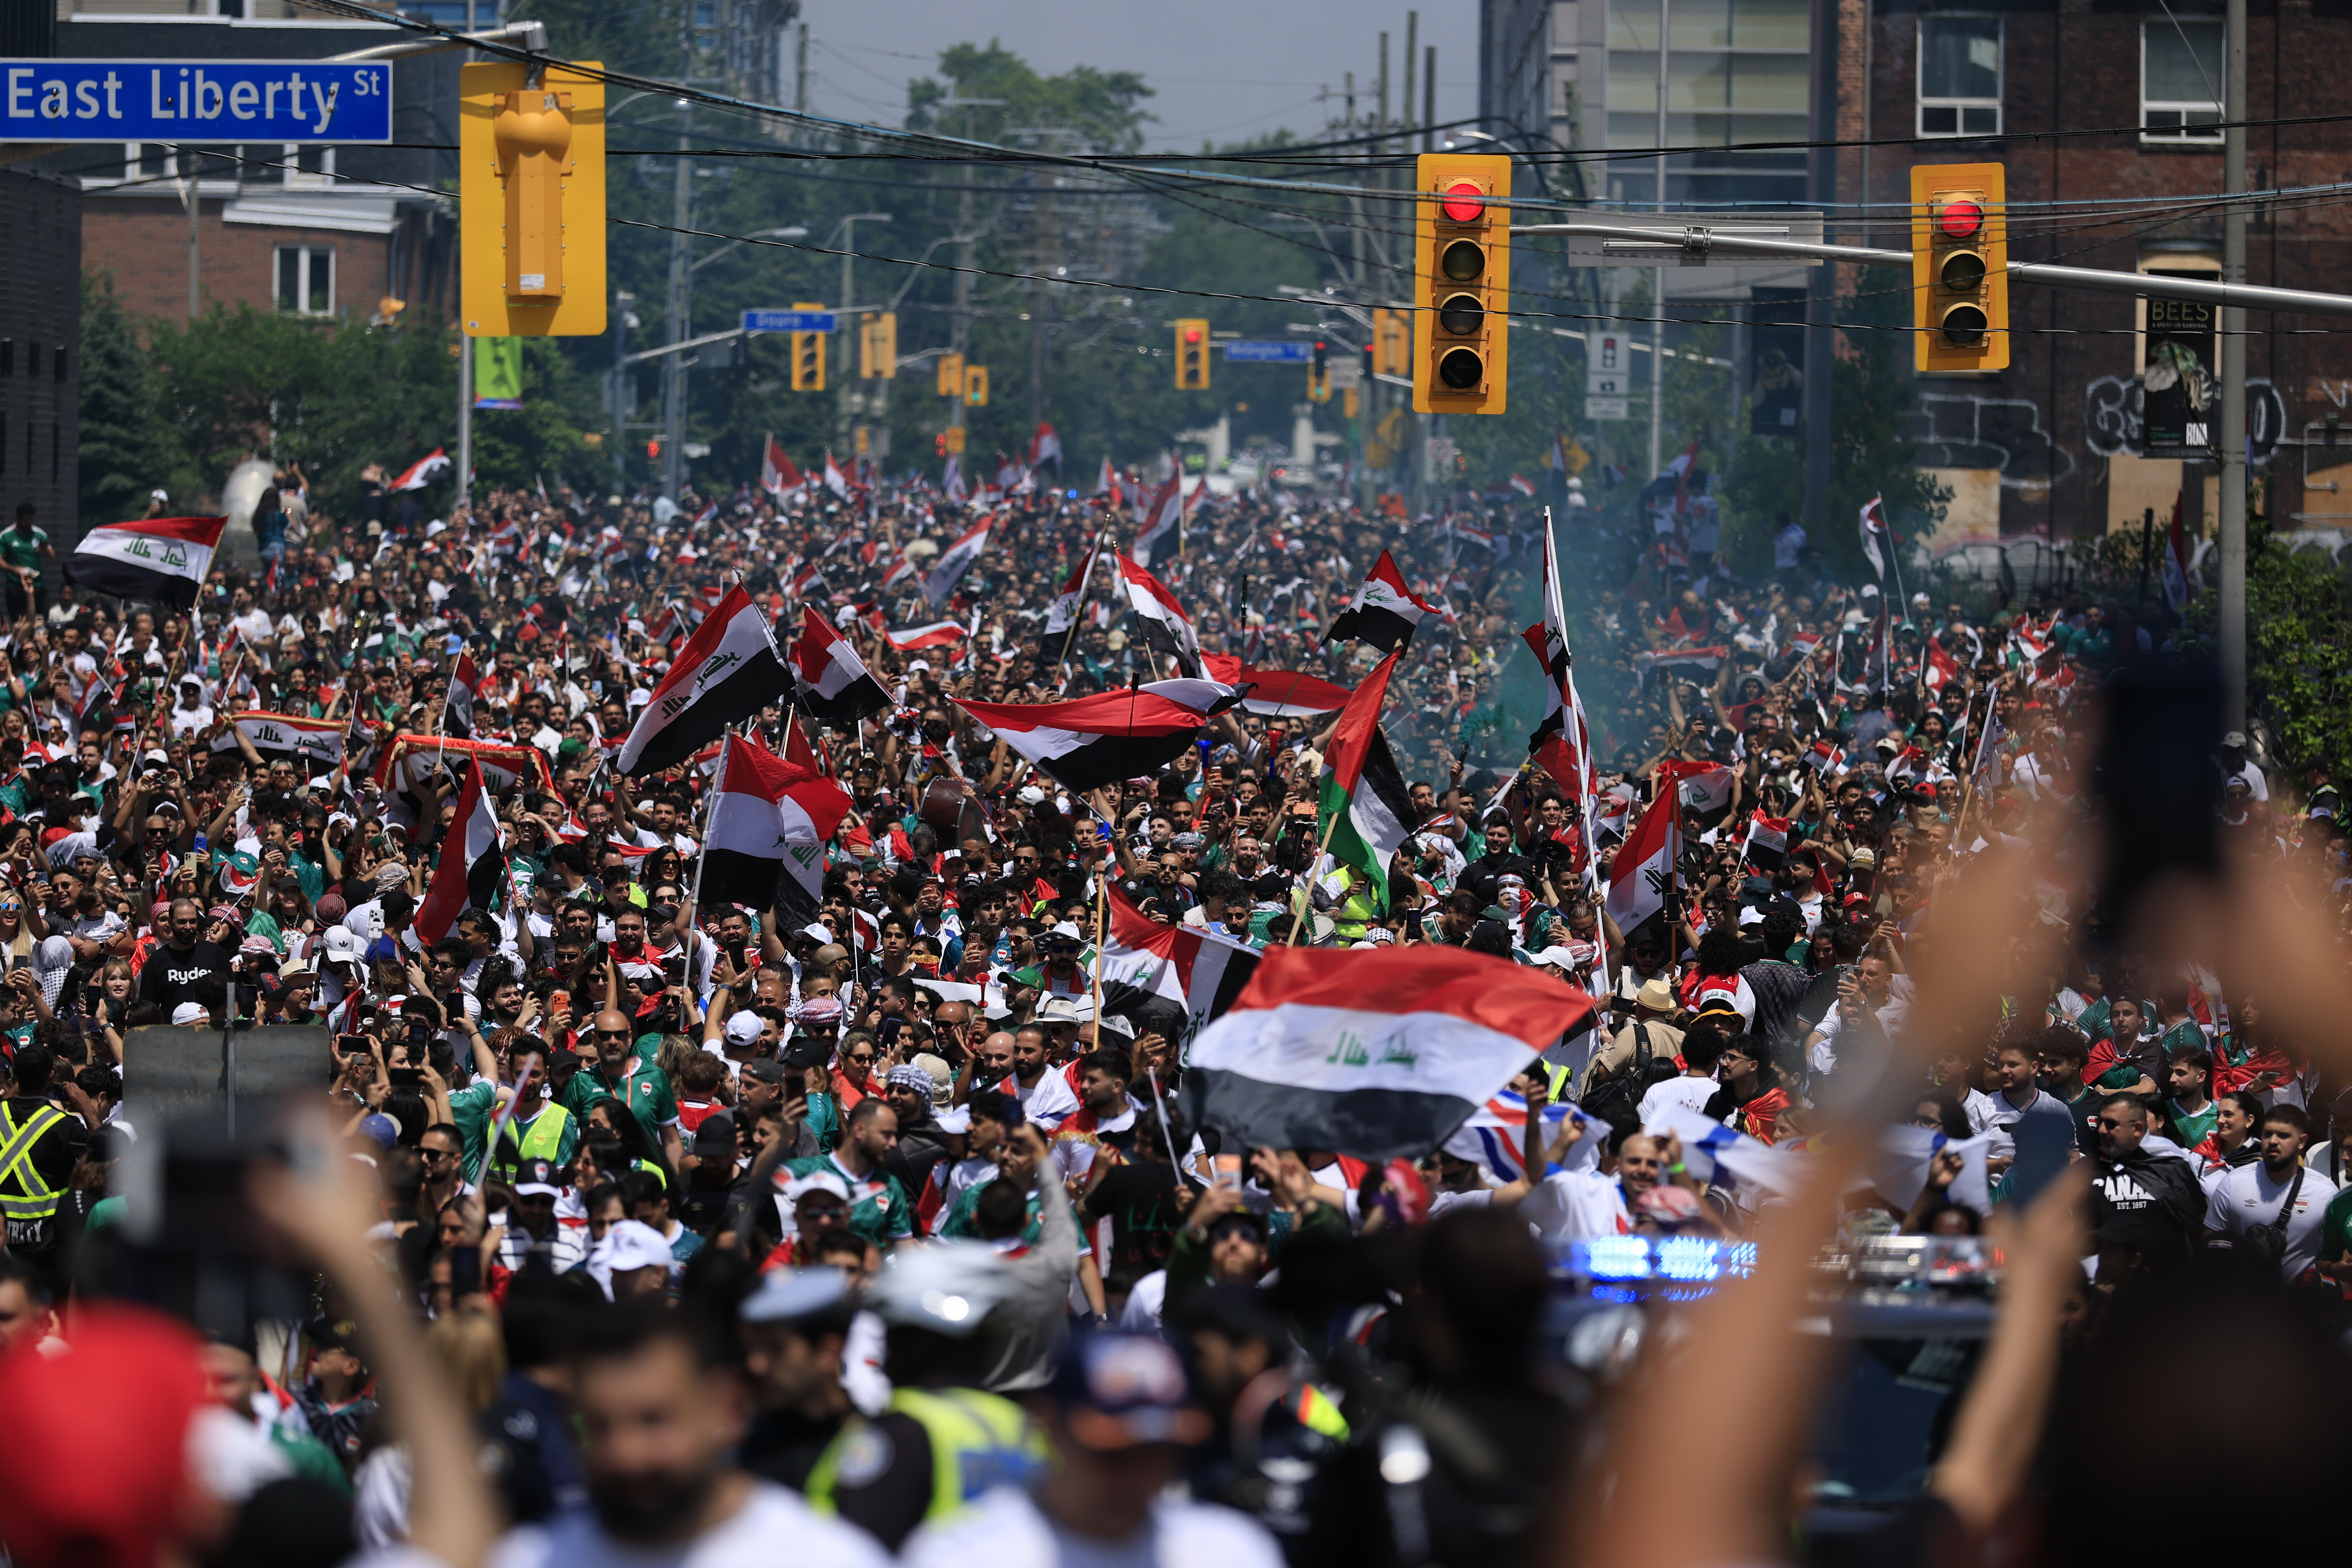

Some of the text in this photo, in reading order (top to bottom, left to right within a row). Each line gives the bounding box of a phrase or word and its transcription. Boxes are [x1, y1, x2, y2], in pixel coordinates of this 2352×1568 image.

[8, 68, 380, 134] East Liberty St
[2152, 301, 2209, 321] BEES
[2186, 422, 2208, 446] ROM
[2116, 1201, 2131, 1210] EST.
